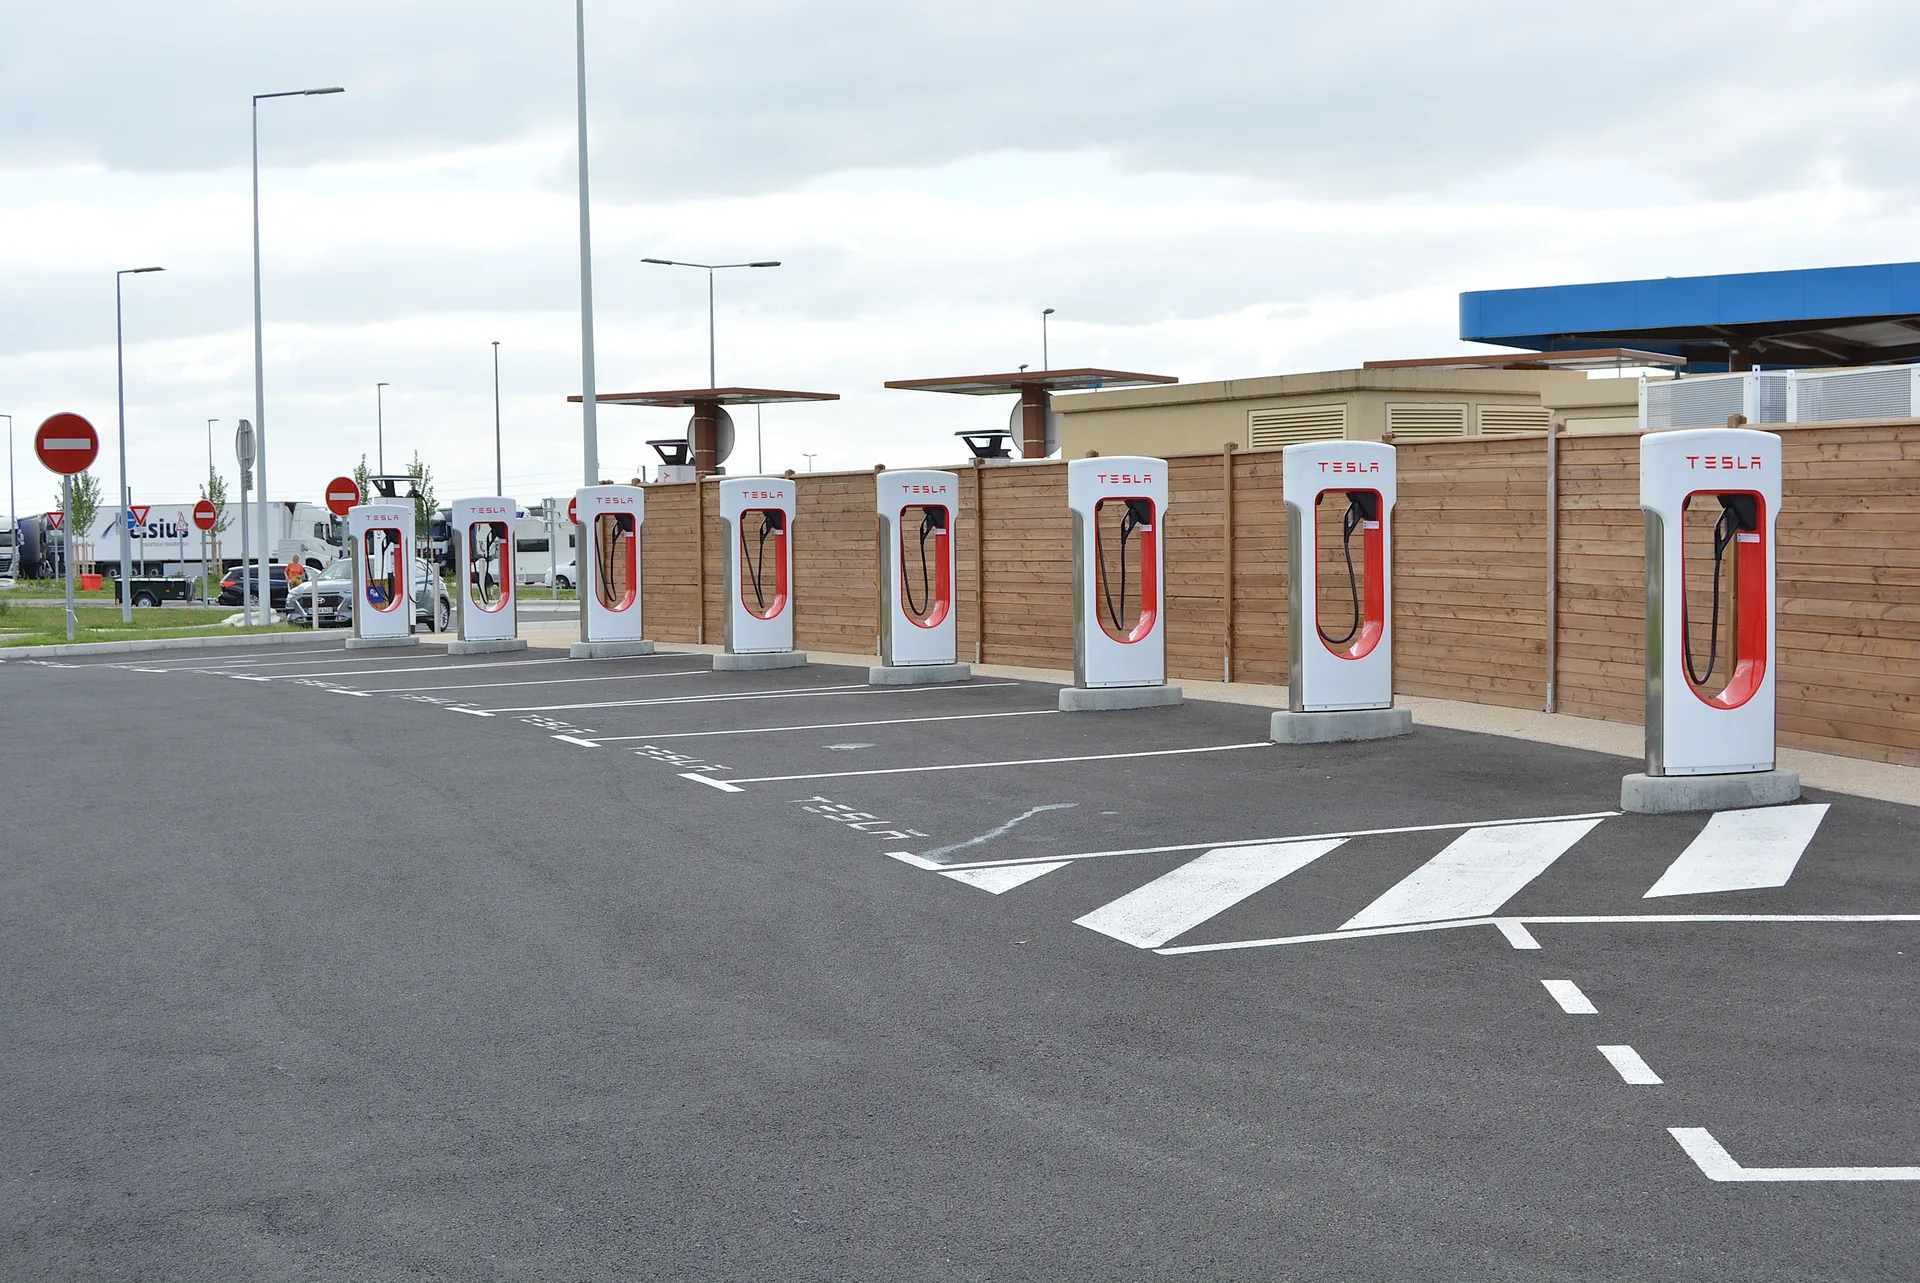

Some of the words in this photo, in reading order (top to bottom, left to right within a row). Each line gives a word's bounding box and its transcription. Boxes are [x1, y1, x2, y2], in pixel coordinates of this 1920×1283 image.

[1318, 461, 1380, 473] TESLA
[1687, 455, 1763, 470] TESLA
[1098, 474, 1152, 484] TESLA
[742, 491, 784, 499] TESLA
[903, 485, 947, 495] TESLA
[625, 745, 733, 772] TESLA
[784, 796, 930, 840] TESLA
